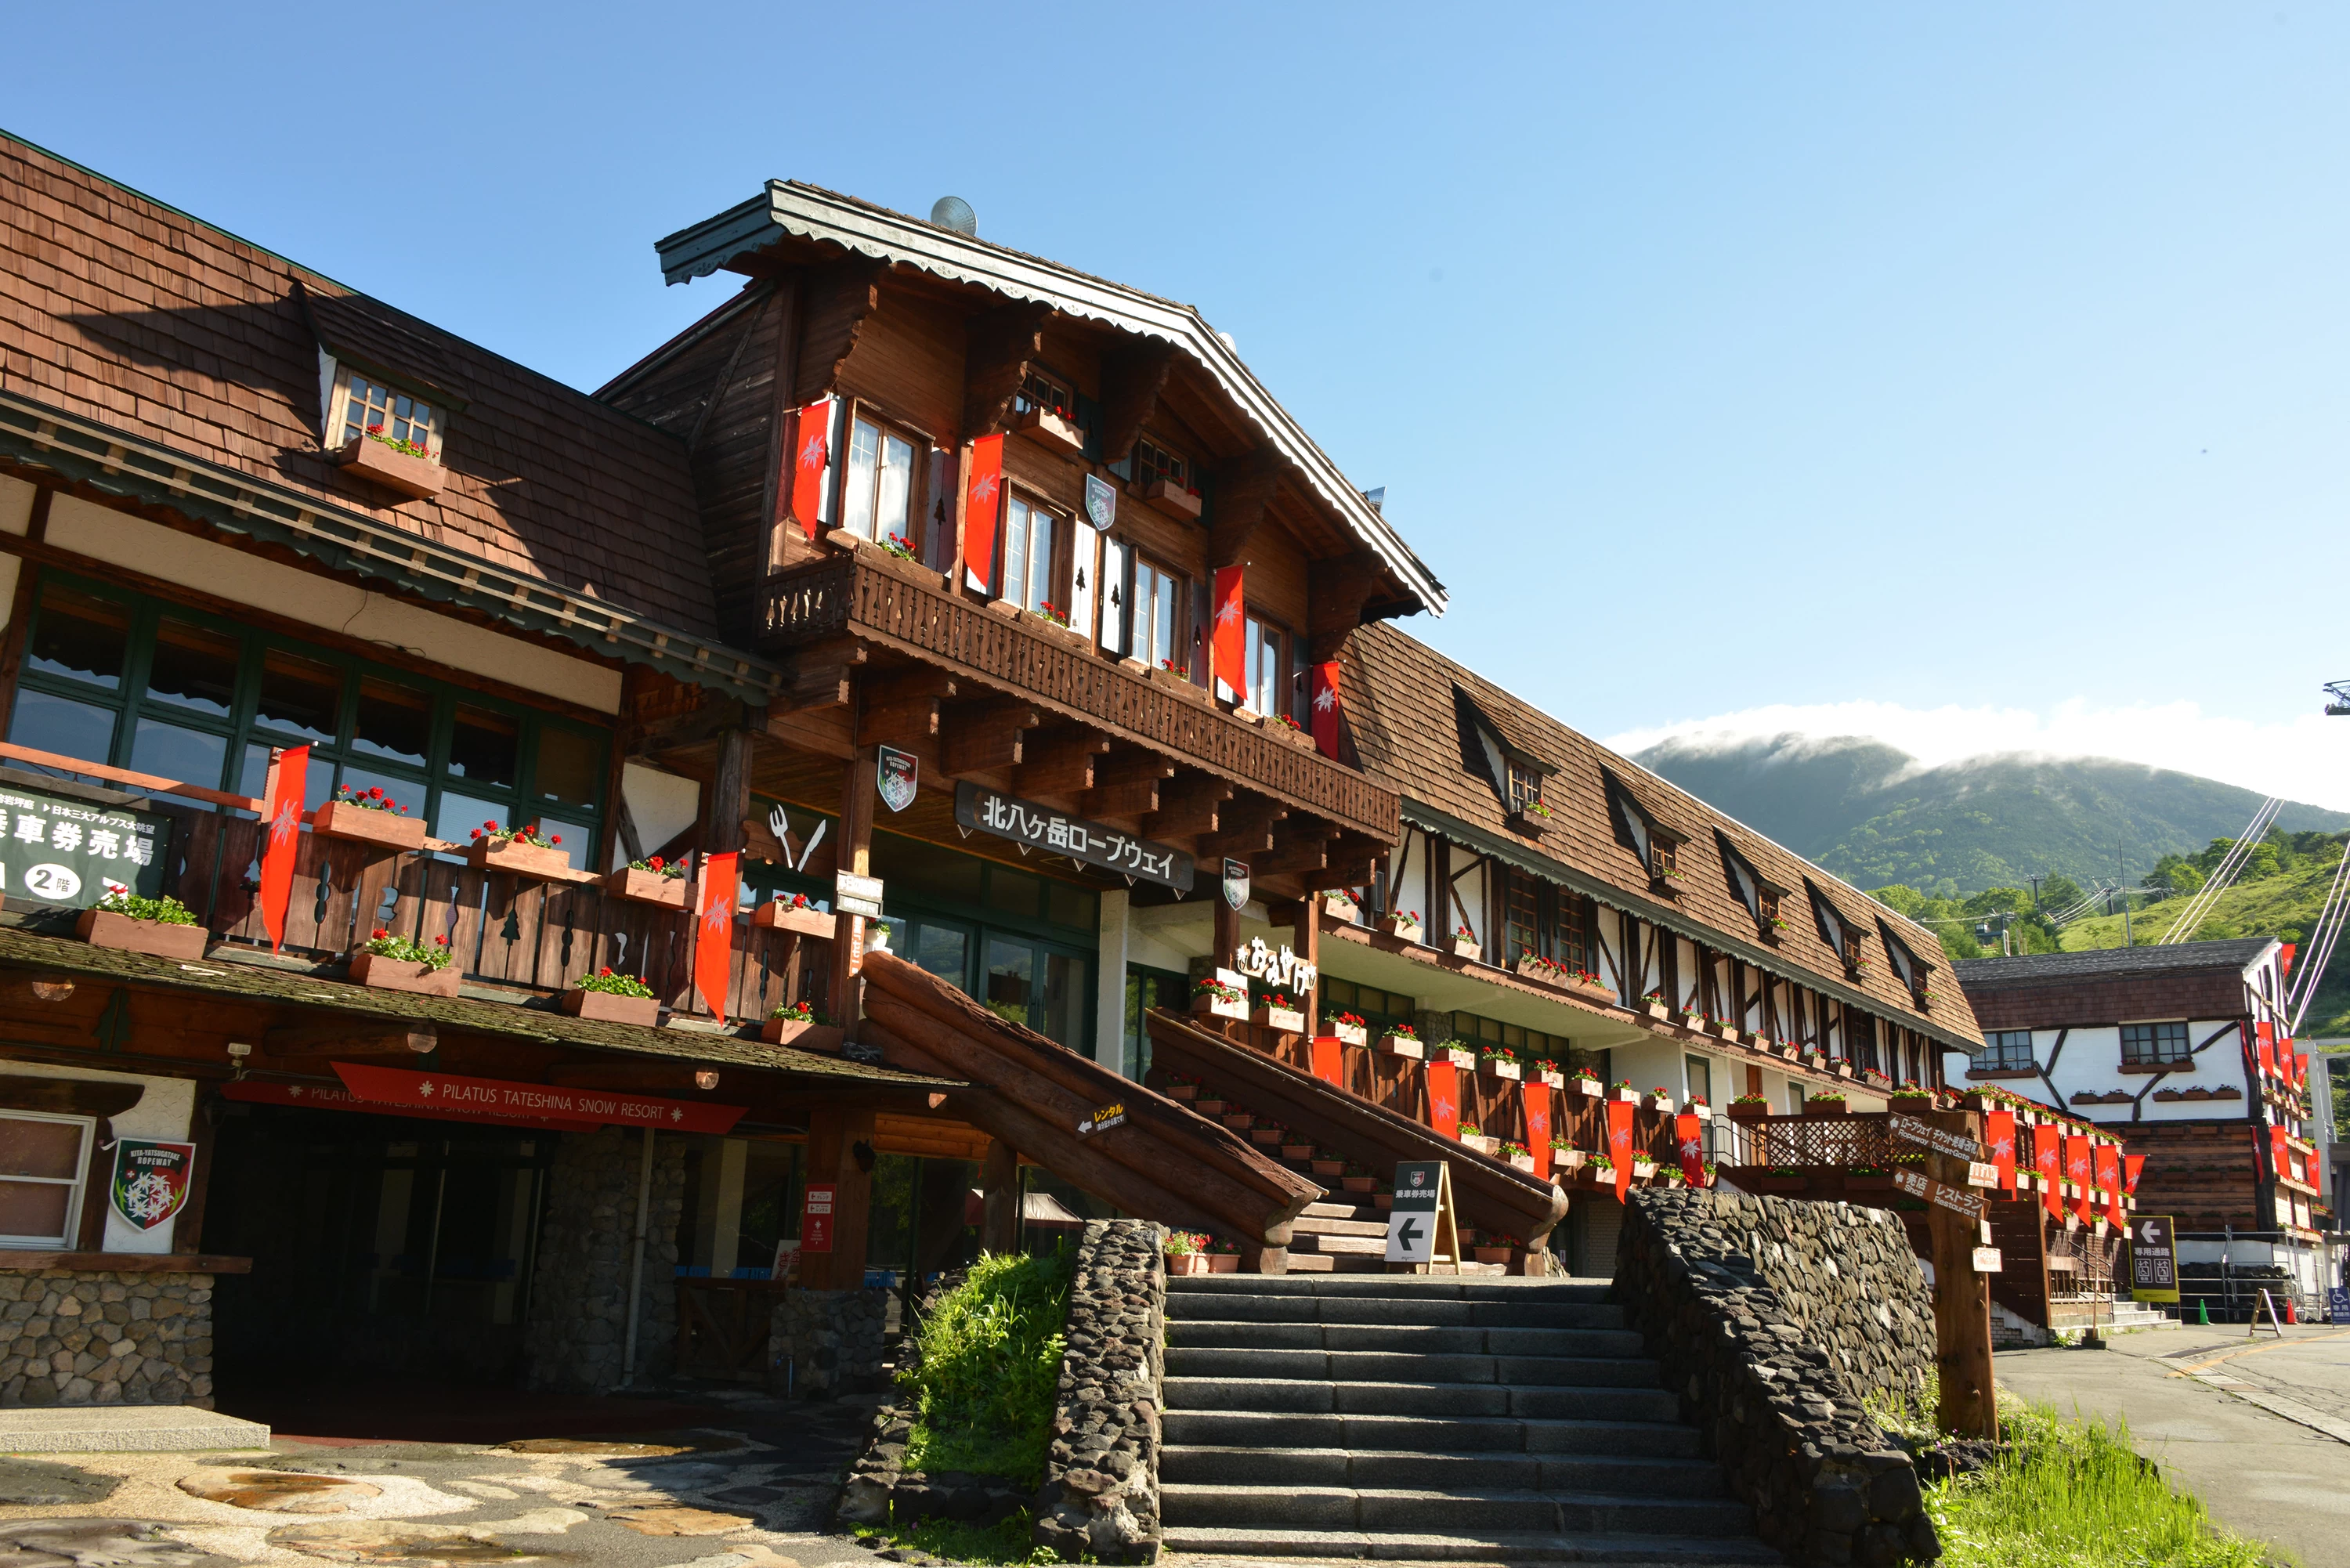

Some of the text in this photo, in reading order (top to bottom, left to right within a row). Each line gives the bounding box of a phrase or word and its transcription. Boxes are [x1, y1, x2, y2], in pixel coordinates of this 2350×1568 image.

[52, 805, 155, 835] 日本三大アルプス大眺望
[0, 808, 154, 866] 車券売場
[443, 1084, 664, 1119] PILATUS TATESHINA SNOW RESORT
[1094, 1104, 1123, 1122] レンタル
[1900, 1118, 1932, 1137] ロープウェイ
[1898, 1129, 1929, 1146] Ropeway
[137, 1157, 172, 1166] ROPEWAY
[1395, 1190, 1435, 1198] 乗車券売場
[1906, 1172, 1983, 1209] 売店 レストラン
[1904, 1184, 1977, 1218] Shop Restaurant
[2134, 1247, 2170, 1256] 専用通路
